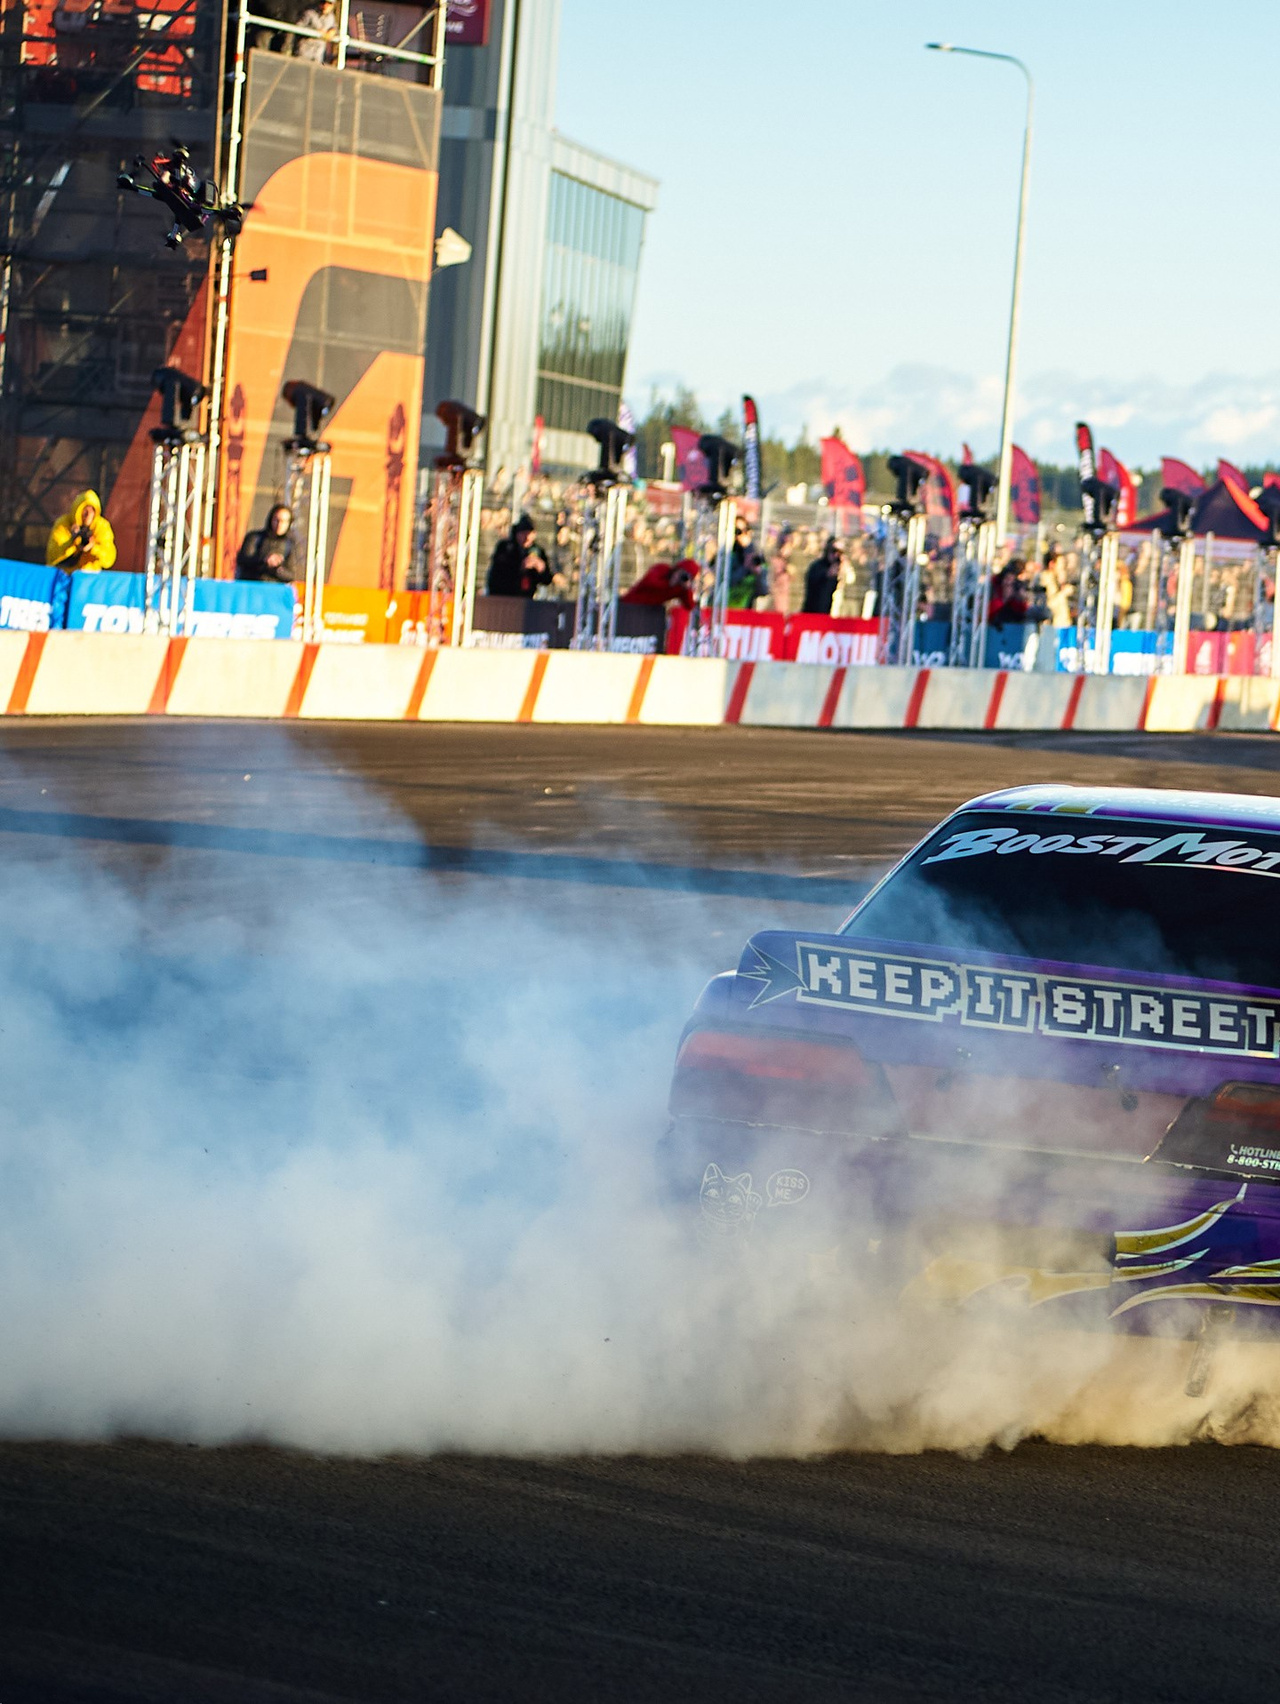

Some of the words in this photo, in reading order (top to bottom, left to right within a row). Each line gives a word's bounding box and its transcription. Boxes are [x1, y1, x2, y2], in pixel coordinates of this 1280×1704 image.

[807, 953, 955, 1007] KEEP
[973, 975, 1031, 1019] IT
[1053, 986, 1275, 1046] STREET
[775, 1176, 805, 1190] KISS
[775, 1187, 792, 1200] ME
